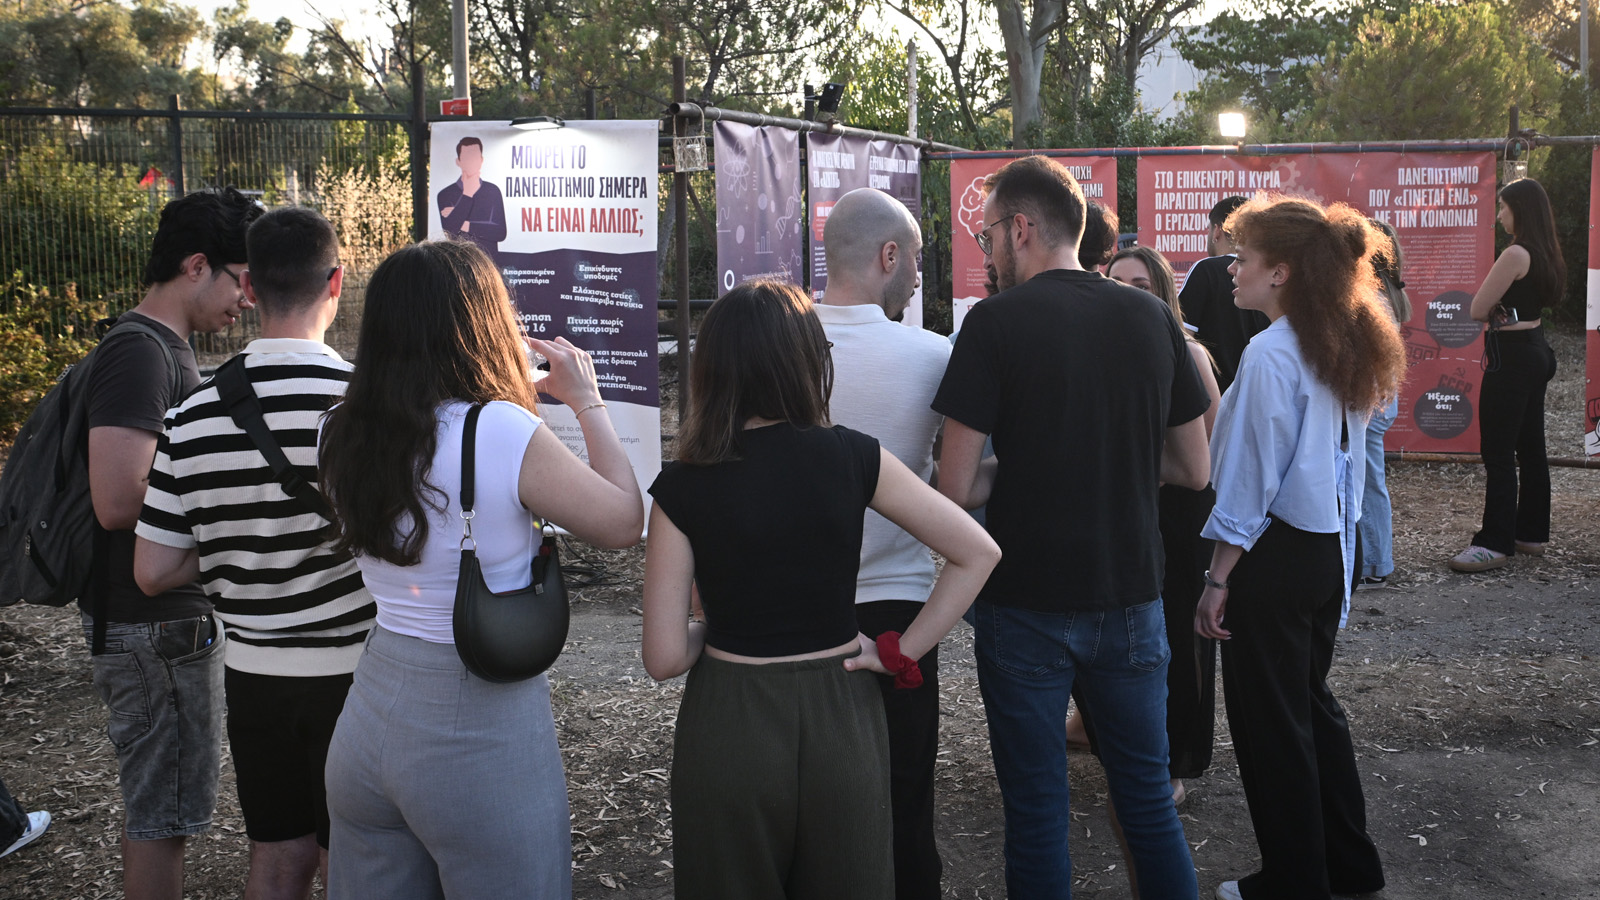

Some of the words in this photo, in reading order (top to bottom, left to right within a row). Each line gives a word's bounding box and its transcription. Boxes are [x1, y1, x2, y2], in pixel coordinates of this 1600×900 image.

[511, 145, 564, 169] ΜΠΟΡΕΙ
[571, 145, 587, 169] ΤΟ
[1065, 166, 1092, 180] ΠΟΧΗ
[1398, 166, 1479, 186] ΠΑΝΕΠΙΣΤΗΜΙΟ
[1154, 171, 1173, 189] ΣΤΟ
[1177, 170, 1235, 188] ΕΠΙΚΕΝΤΡΟ
[1238, 171, 1246, 188] Η
[1249, 170, 1281, 188] ΚΥΡΙΑ
[505, 176, 595, 198] ΠΑΝΕΠΙΣΤΗΜΙΟ
[599, 177, 648, 199] ΣΗΜΕΡΑ
[1155, 192, 1218, 210] ΠΑΡΑΓΩΓΙΚΗ
[1369, 189, 1391, 207] ΠΟΥ
[1394, 188, 1445, 207] «ΓΙΝΕΤΑΙ
[1448, 188, 1478, 206] ΕΝΑ»
[521, 207, 542, 232] ΝΑ
[547, 207, 585, 232] ΕΙΝΑΙ
[590, 208, 644, 238] ΑΛΛΙΩΣ;
[1155, 213, 1162, 231] Ο
[1165, 213, 1210, 231] ΕΡΓΑΖΟΜ
[1394, 210, 1417, 228] ΤΗΝ
[1421, 209, 1478, 228] ΚΟΙΝΩΝΙΑ!
[503, 268, 555, 276] Απαρχαιωμένα
[579, 264, 622, 274] Επικίνδυνες
[509, 277, 550, 285] εργαστήρια
[584, 273, 618, 282] υποδομές
[572, 286, 609, 298] Ελάχιστες
[611, 291, 633, 301] εστίες
[574, 295, 614, 306] πανάκριβα
[616, 300, 643, 309] ενοίκια
[1426, 301, 1461, 311] Ήξερες
[515, 311, 552, 323] ώρηση
[1436, 311, 1453, 320] ότι;
[567, 316, 598, 326] Πτυχία
[600, 317, 624, 327] χωρίς
[533, 323, 546, 333] 16
[572, 325, 619, 335] αντίκρισμα
[611, 350, 648, 358] καταστολή
[611, 357, 637, 366] δράσης
[597, 382, 647, 391] ανεπιστήμια»
[1425, 392, 1460, 402] Ήξερες
[1435, 402, 1452, 411] ότι;
[619, 436, 640, 444] στήμη
